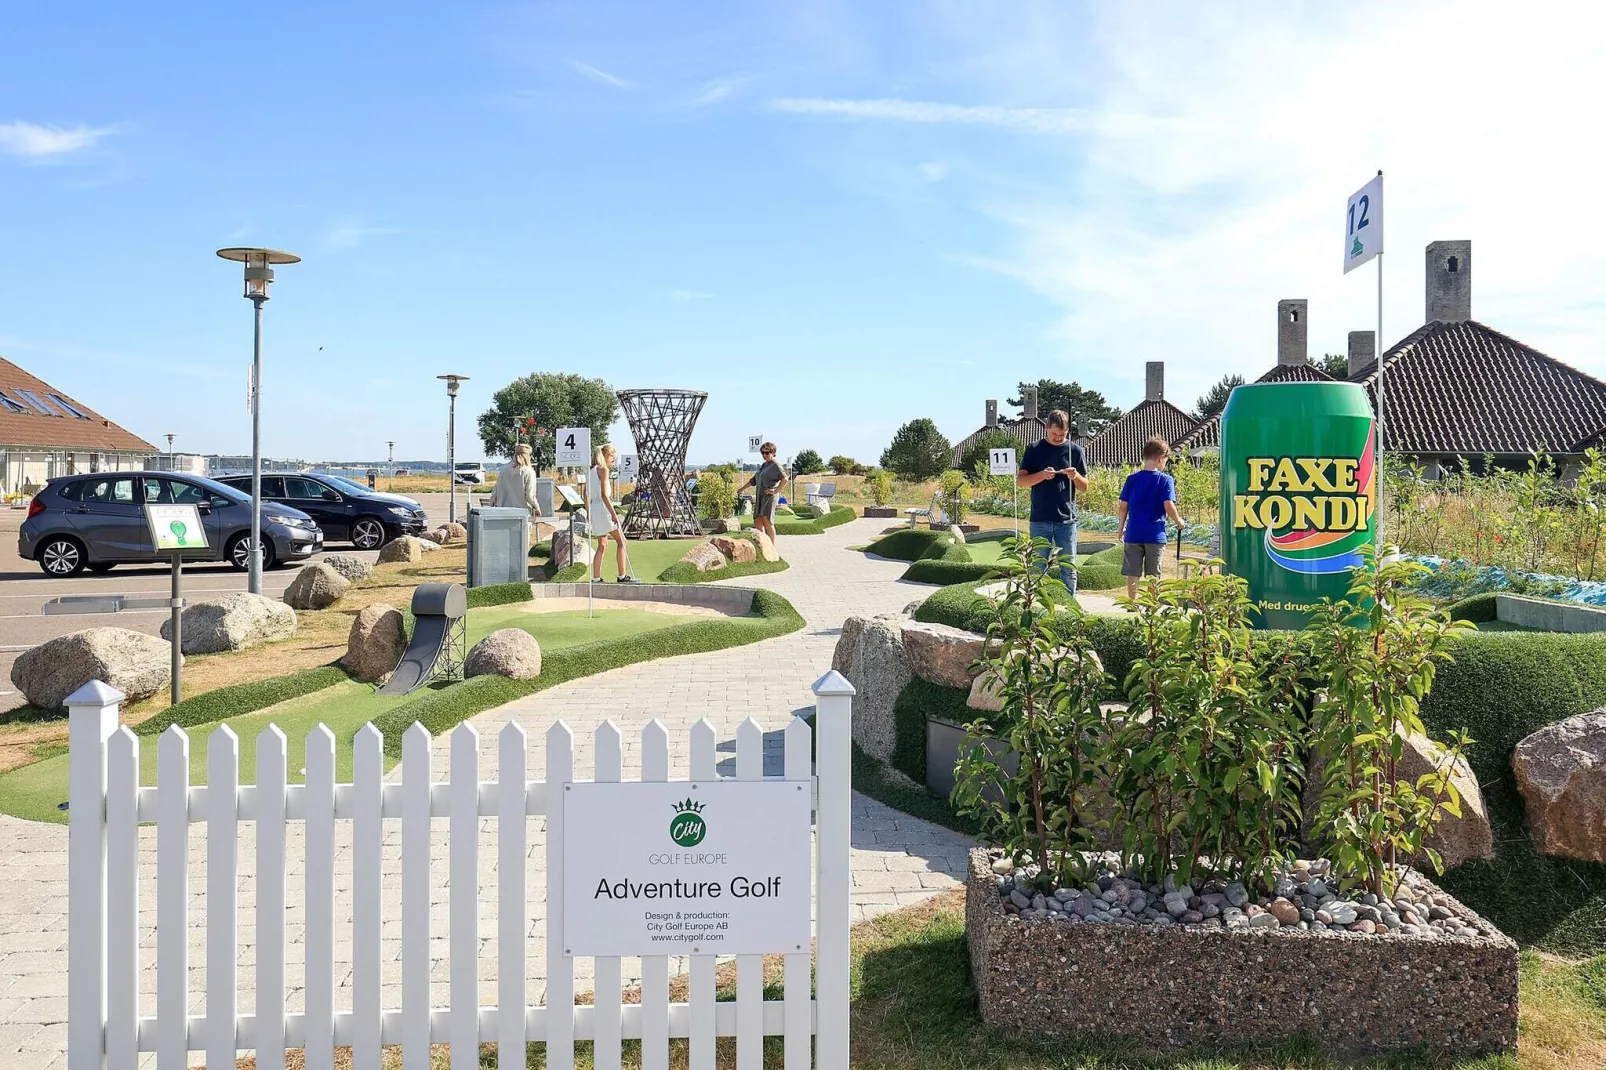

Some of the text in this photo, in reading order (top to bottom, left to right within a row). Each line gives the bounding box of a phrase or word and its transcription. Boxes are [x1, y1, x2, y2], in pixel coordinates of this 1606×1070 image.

[1348, 194, 1369, 236] 12
[564, 433, 576, 450] 4
[750, 438, 760, 446] 10
[624, 457, 632, 467] 5
[993, 452, 1008, 464] 11
[1247, 457, 1359, 493] FAXE
[1233, 495, 1368, 530] KONDI
[1258, 600, 1281, 610] Med
[673, 821, 703, 841] City
[648, 853, 728, 865] GOLF EUROPE
[594, 876, 781, 899] Adventure Golf
[645, 911, 731, 921] Design & production:
[646, 921, 729, 932] City Golf Europe AB
[651, 933, 724, 942] www.citygolf.com
